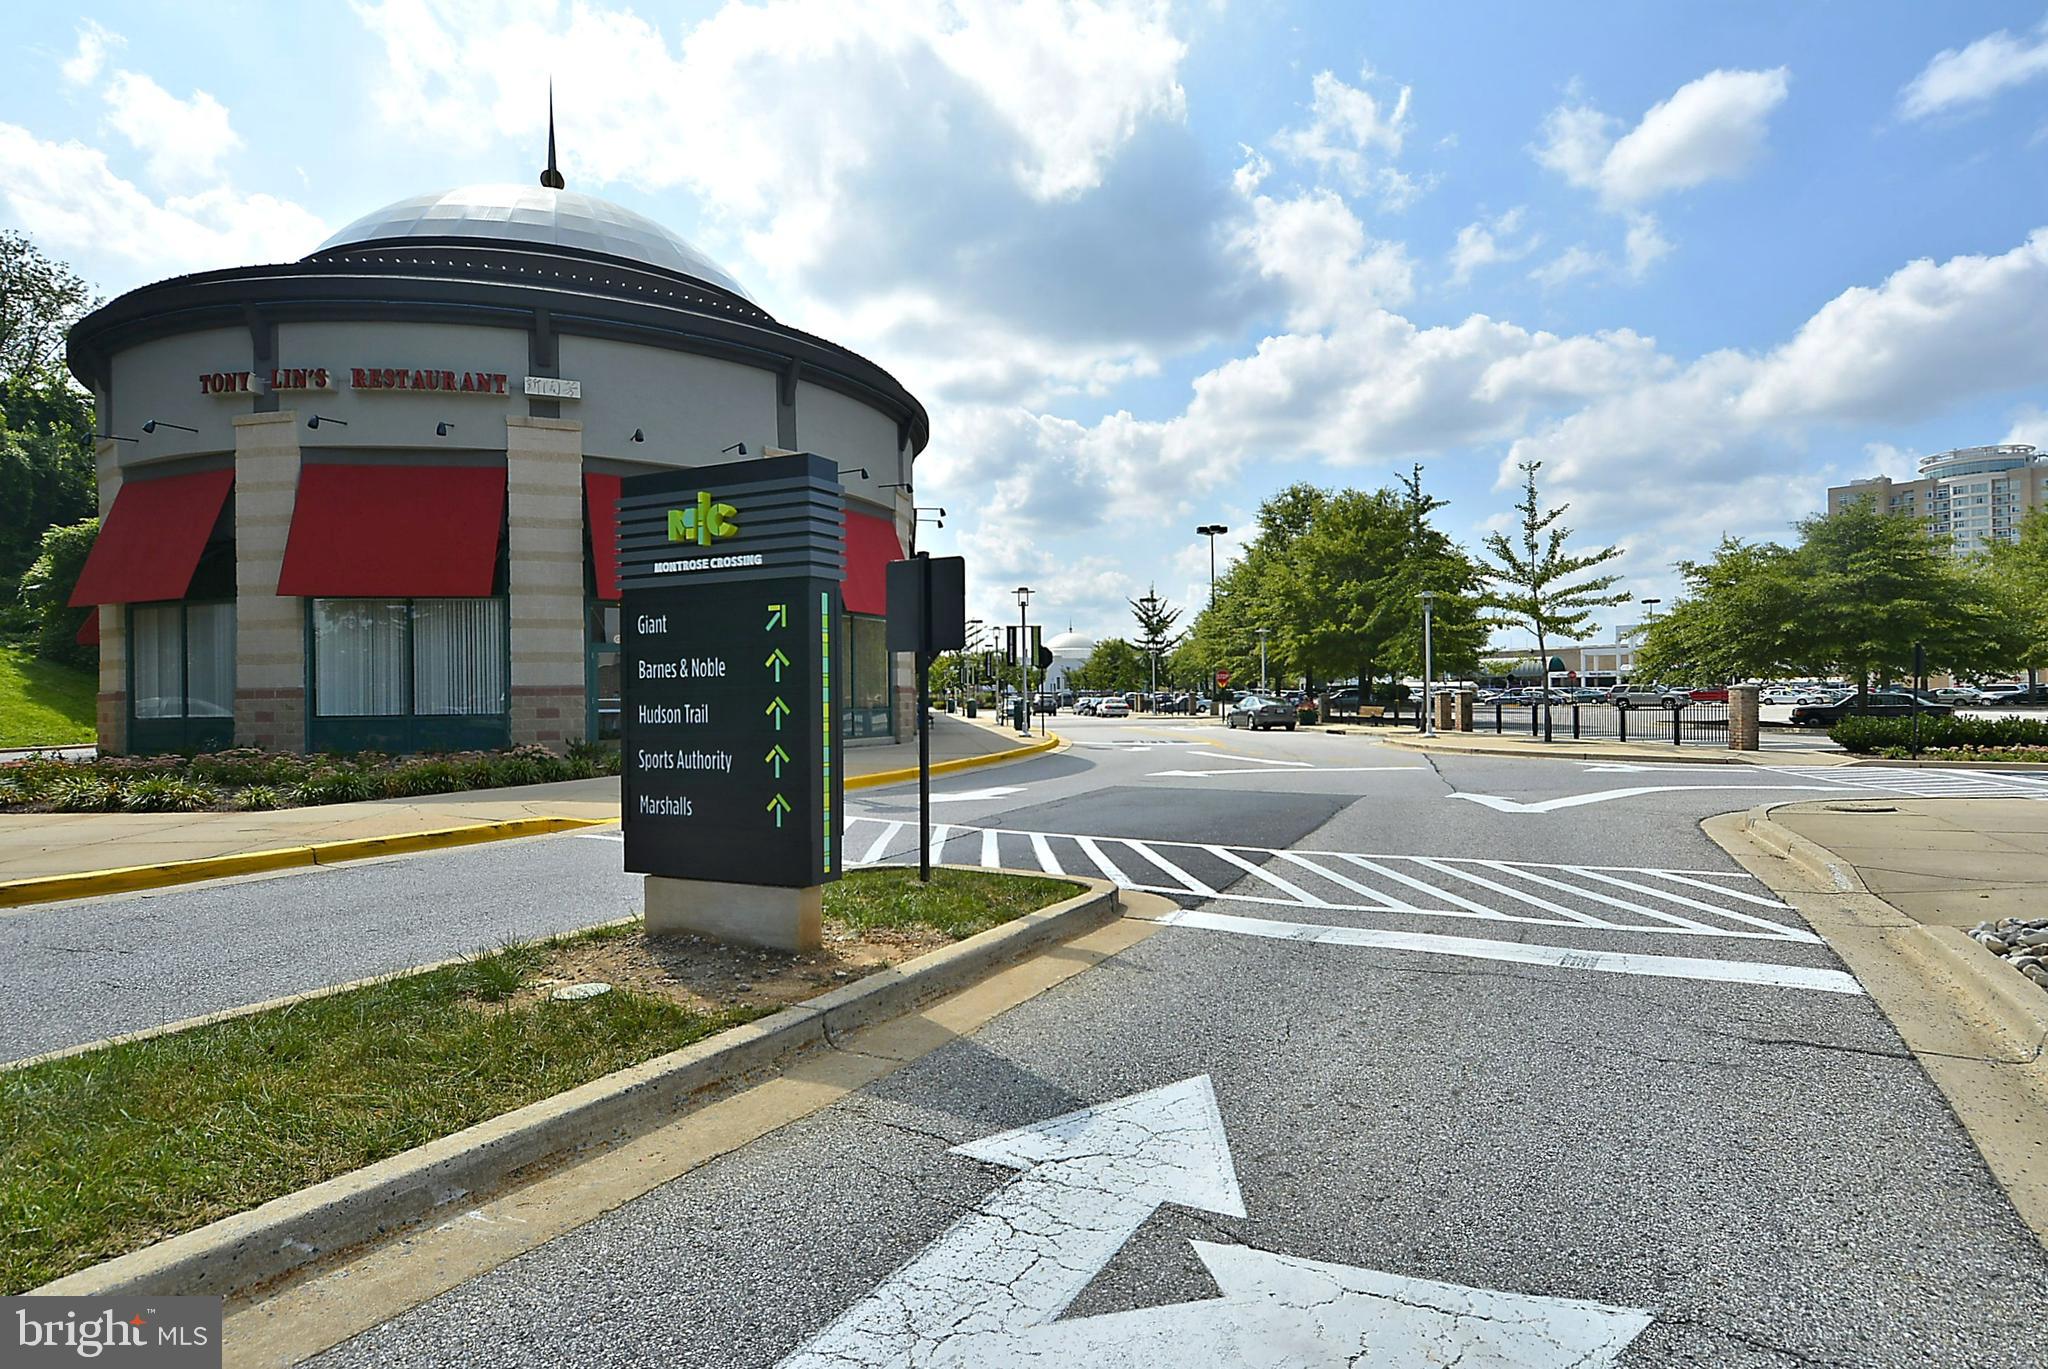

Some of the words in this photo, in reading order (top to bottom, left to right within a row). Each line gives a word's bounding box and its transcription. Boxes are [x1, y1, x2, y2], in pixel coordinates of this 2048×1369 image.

[199, 371, 251, 395] TONY
[271, 367, 330, 390] LIN'S
[350, 367, 509, 395] RESTAURANT
[653, 558, 710, 574] MONTROSE
[709, 554, 763, 569] CROSSING
[637, 614, 668, 635] Giant
[638, 659, 678, 679] Barnes
[679, 658, 689, 678] &
[691, 656, 727, 678] Noble
[638, 704, 682, 725] Hudson
[684, 703, 710, 724] Trail
[638, 749, 674, 773] Sports
[677, 748, 733, 774] Authority
[639, 795, 693, 817] Marshalls
